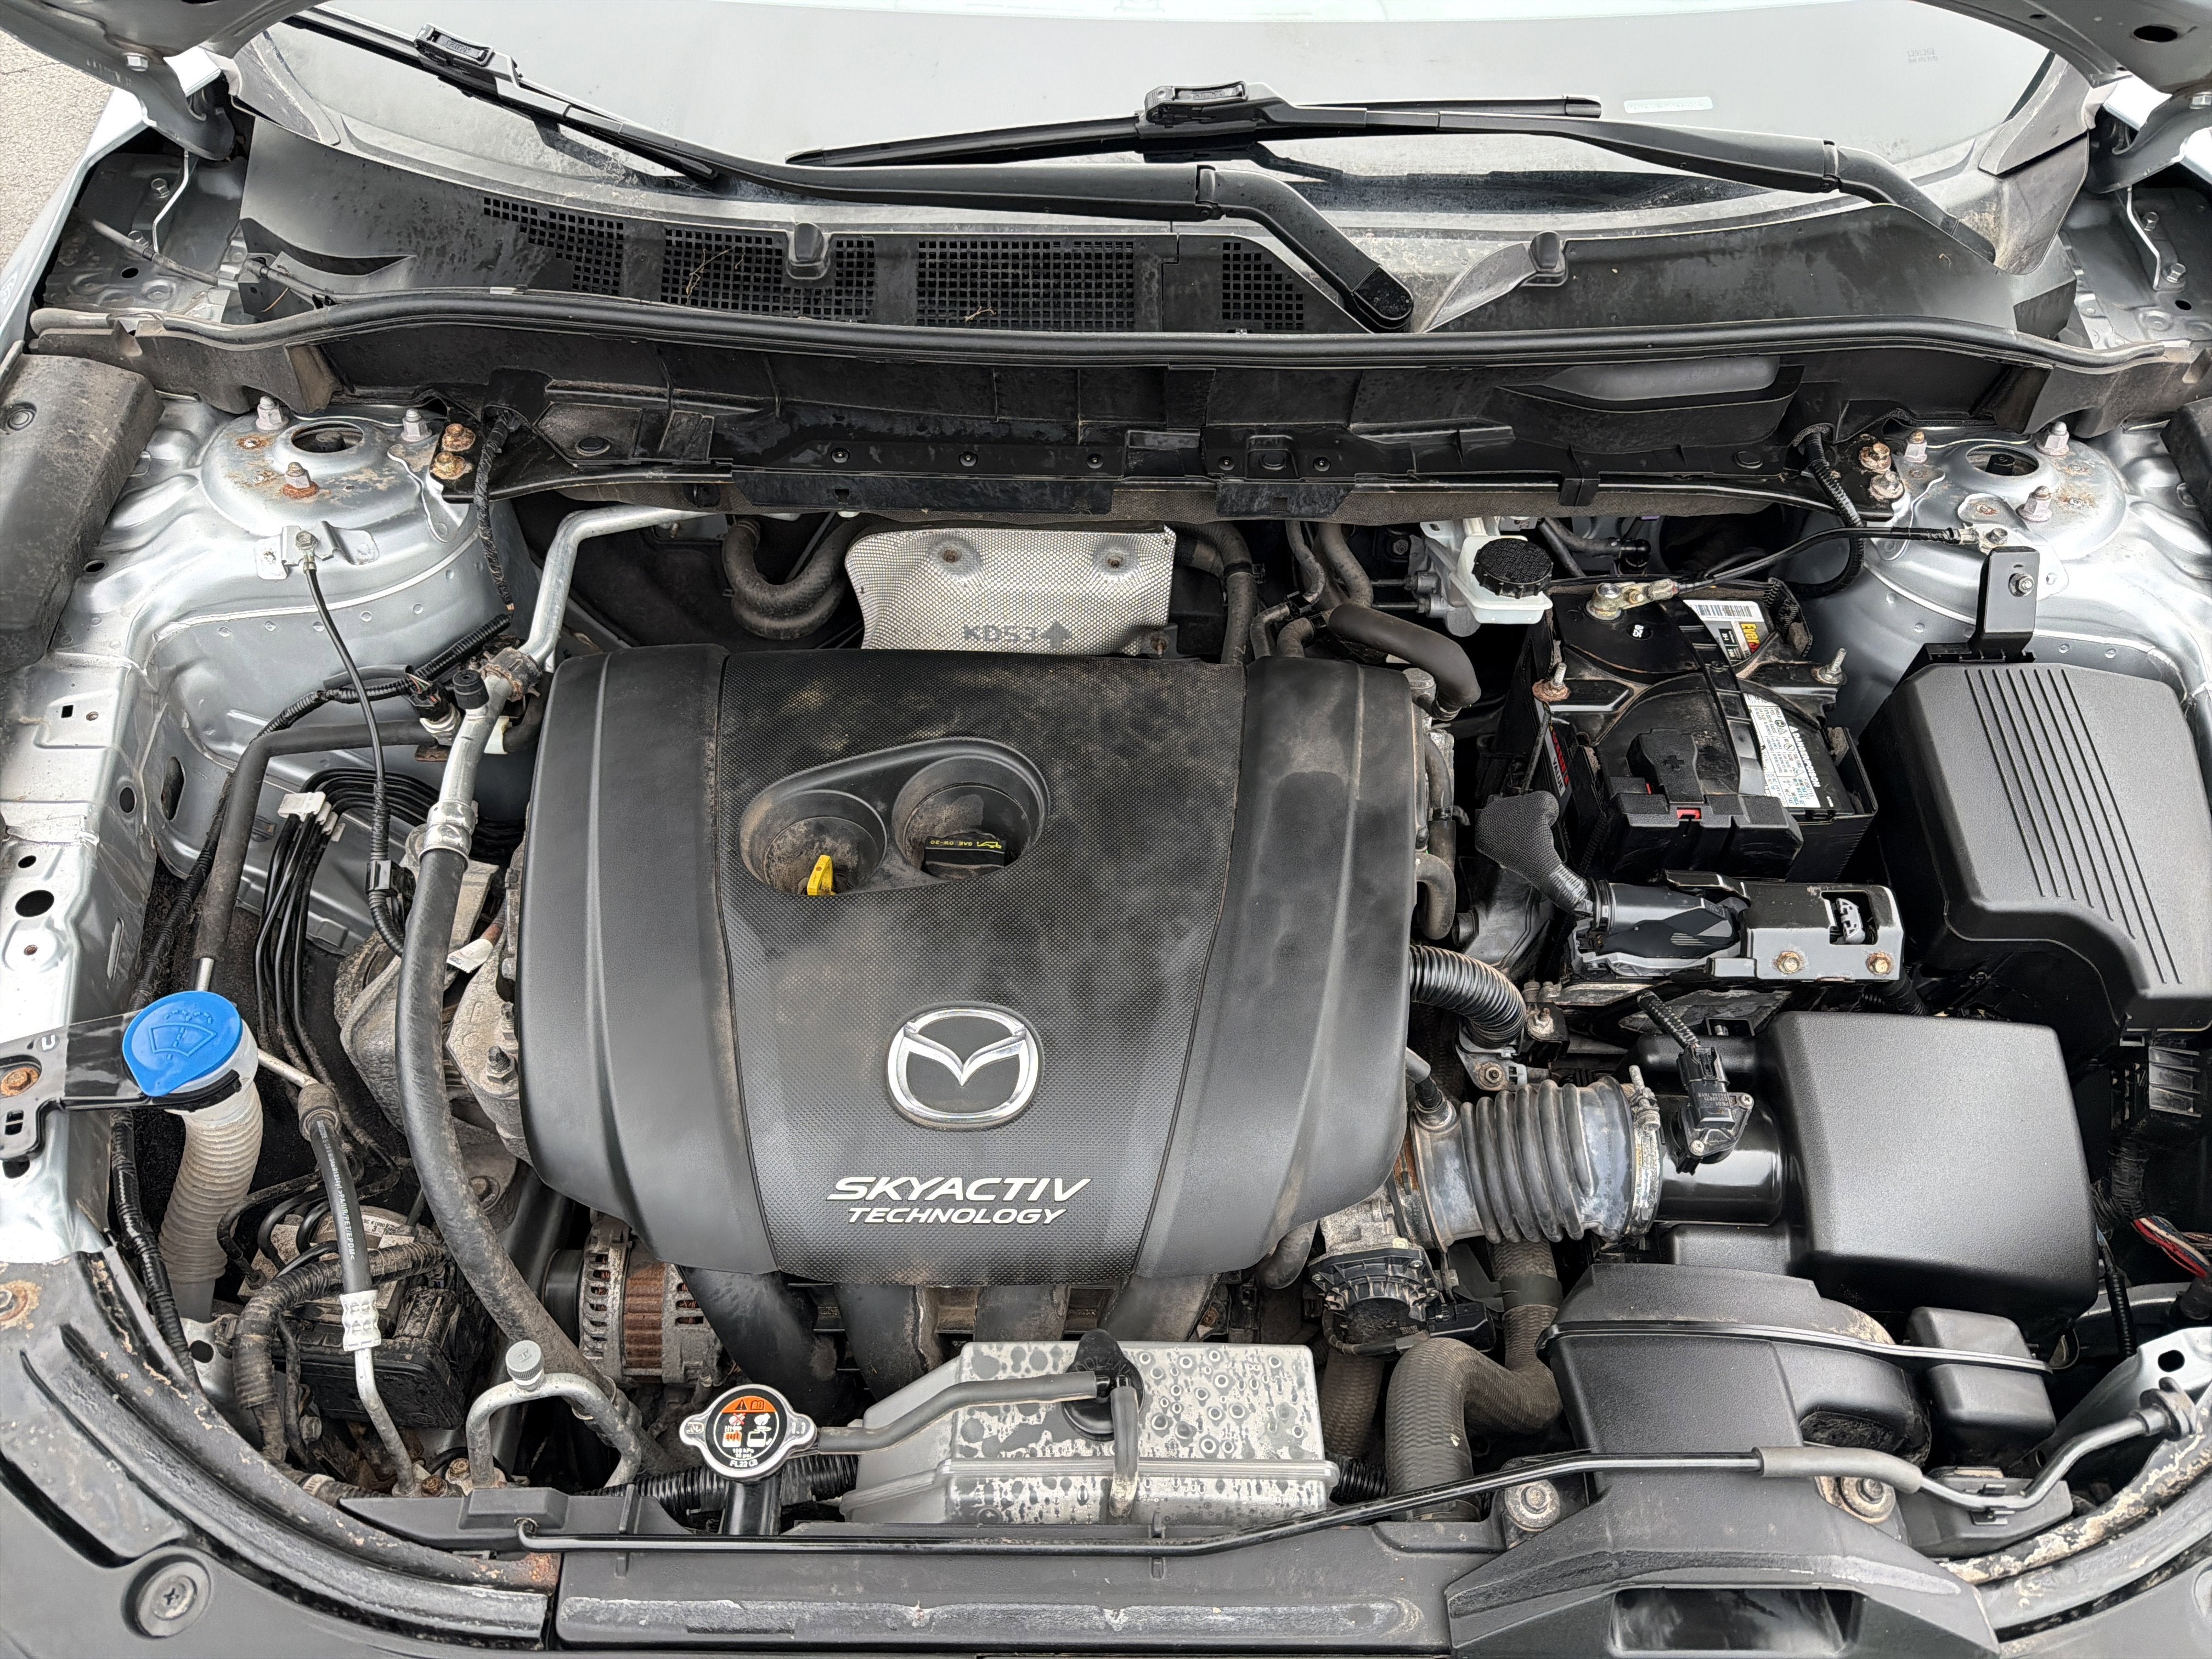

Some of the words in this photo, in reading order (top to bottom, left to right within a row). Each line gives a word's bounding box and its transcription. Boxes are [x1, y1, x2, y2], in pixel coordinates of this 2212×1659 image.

[1792, 733, 1821, 787] DANGER/POISON
[1553, 757, 1562, 791] VALUE
[826, 1176, 1092, 1201] SKYACTIV
[849, 1208, 1068, 1224] TECHNOLOGY
[791, 1421, 805, 1435] 1.1
